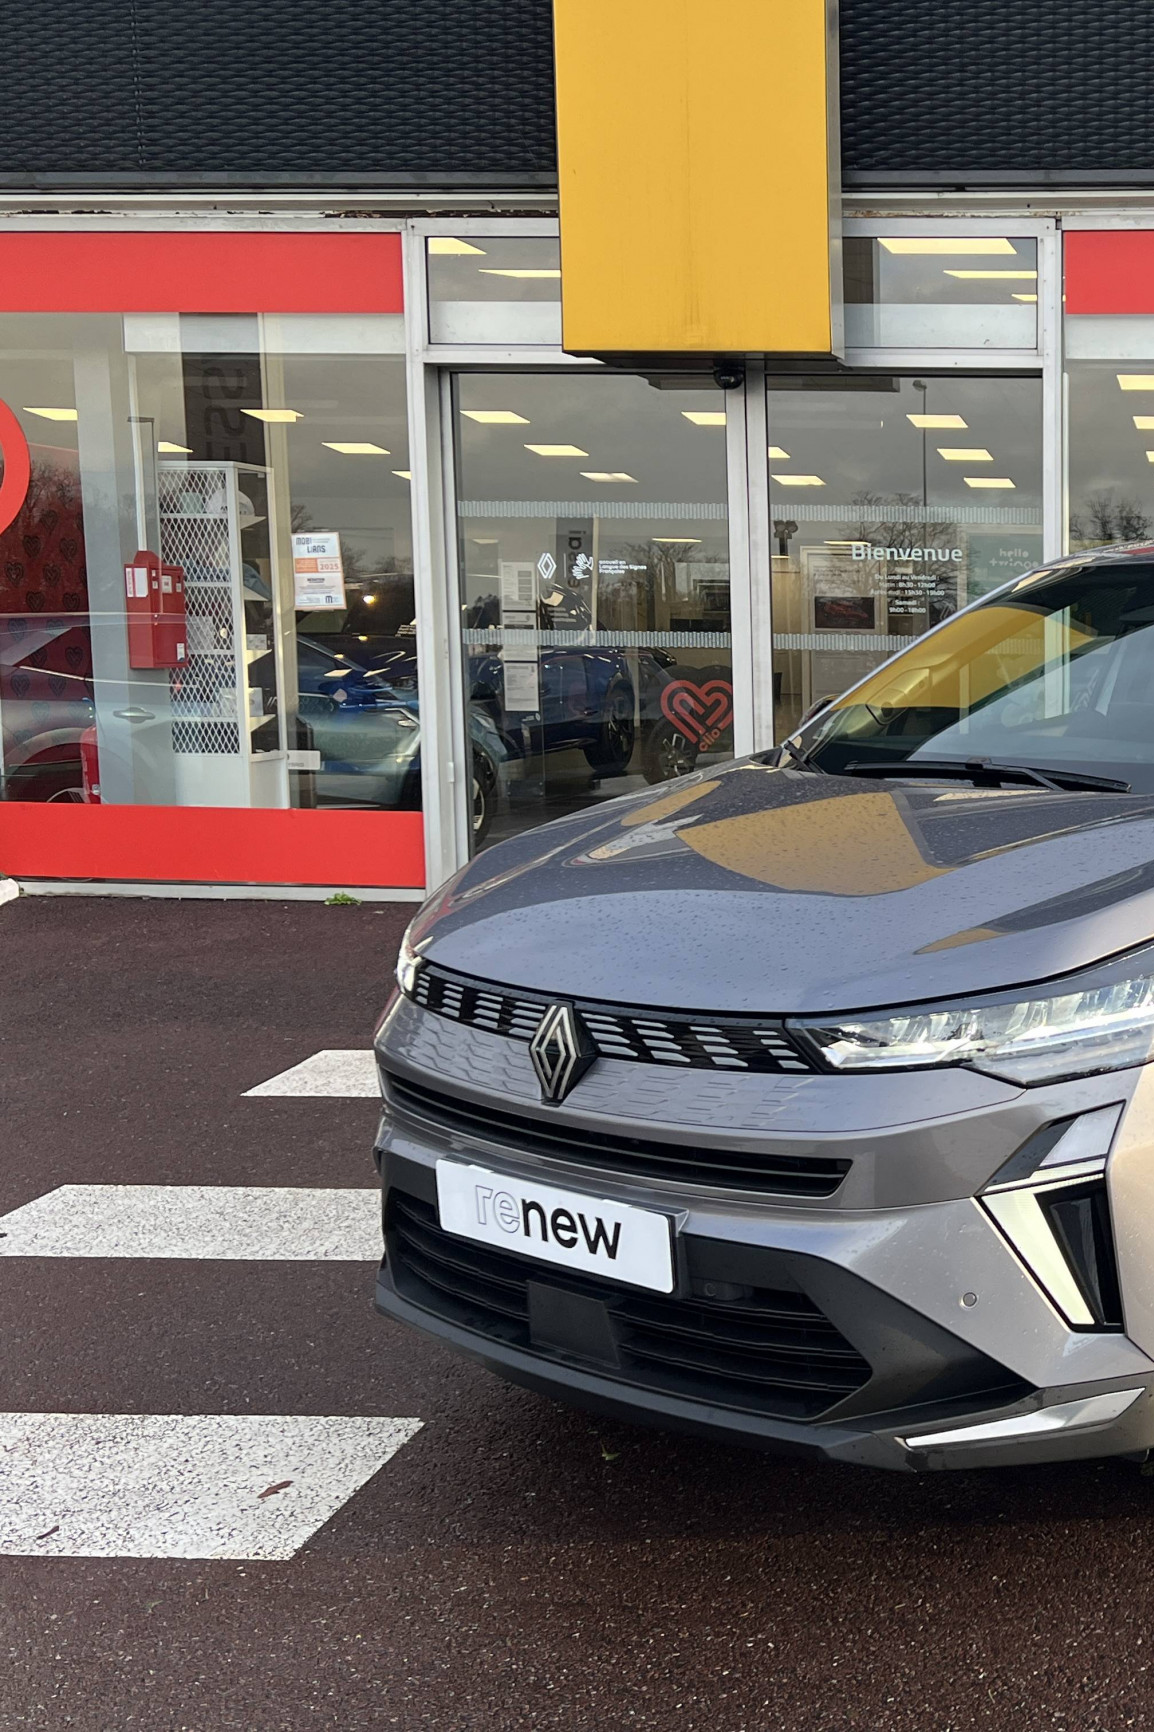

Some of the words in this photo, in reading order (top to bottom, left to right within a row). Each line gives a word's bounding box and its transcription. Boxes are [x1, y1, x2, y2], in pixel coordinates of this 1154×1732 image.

[852, 544, 962, 561] Bienvenue
[1000, 548, 1029, 558] hello
[699, 728, 721, 752] clio
[475, 1185, 621, 1260] renew
